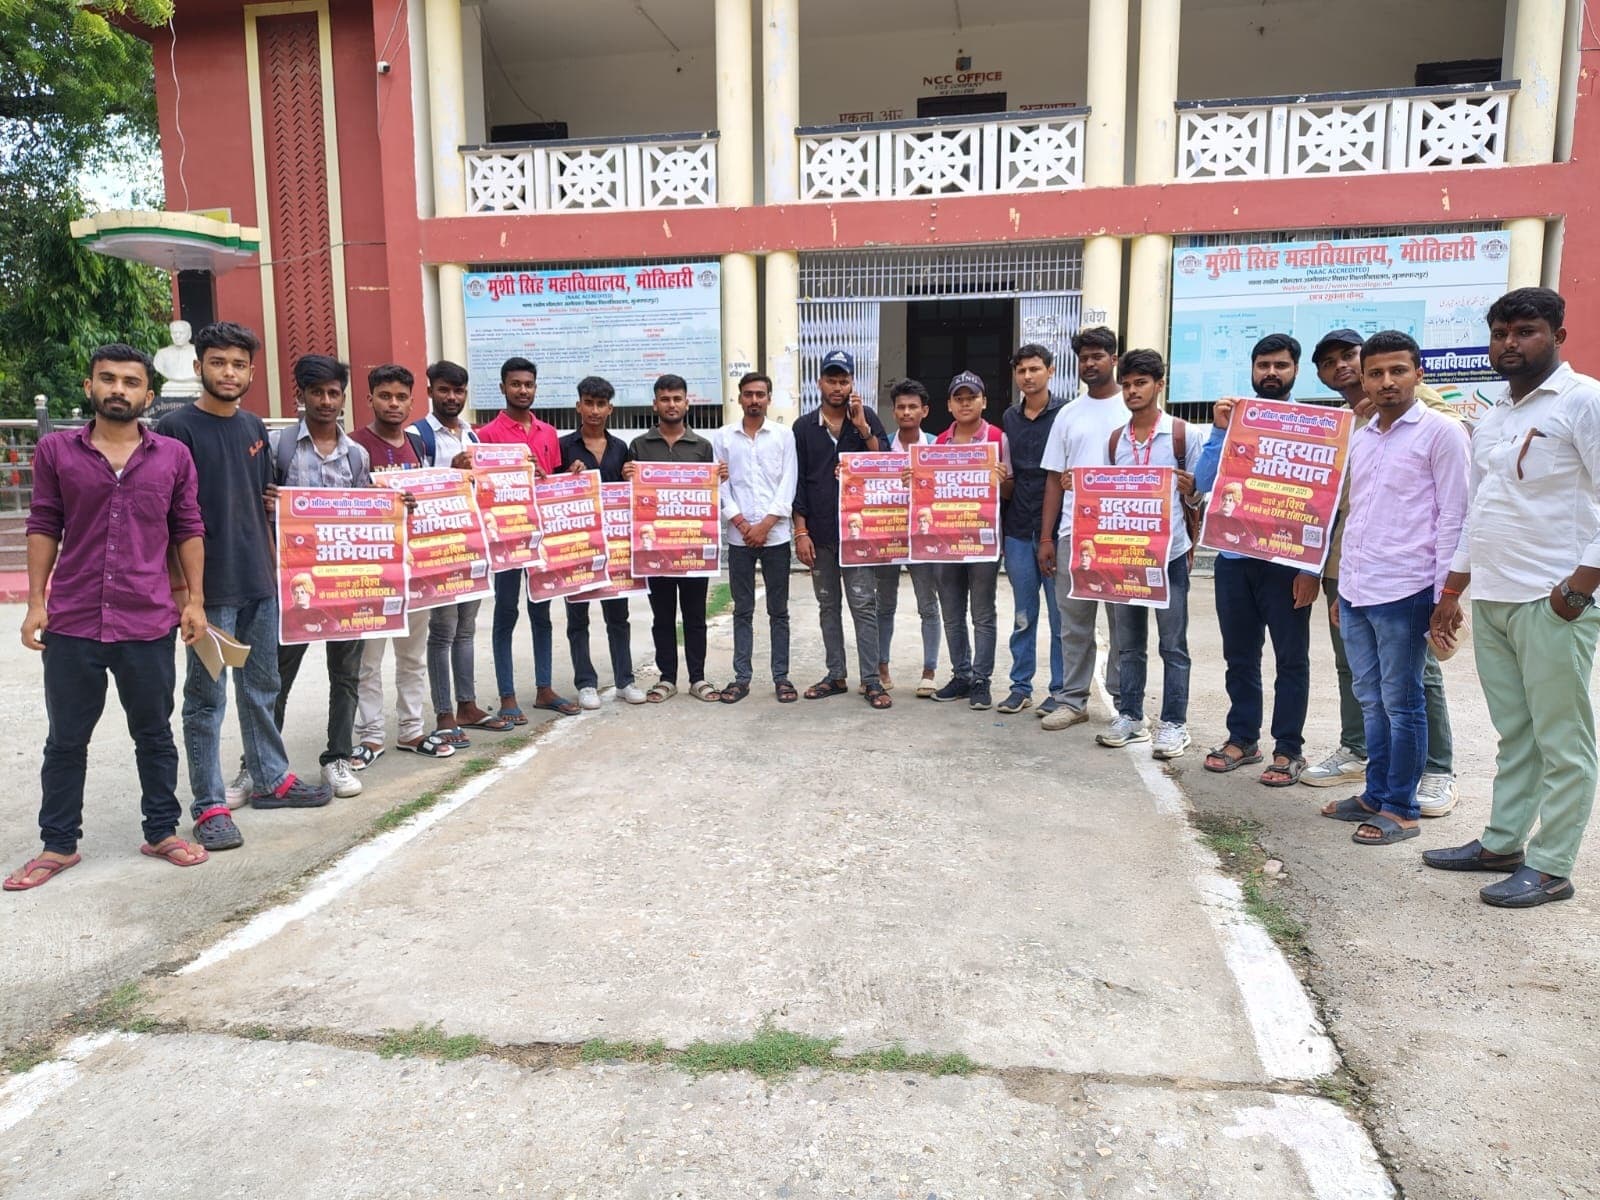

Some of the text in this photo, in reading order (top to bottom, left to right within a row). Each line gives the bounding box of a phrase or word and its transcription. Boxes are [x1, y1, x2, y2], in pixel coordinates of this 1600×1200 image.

[922, 71, 1003, 87] NCC OFFICE
[1205, 236, 1477, 280] मुंशी सिंह महाविद्यालय, मोतिहारी
[1328, 266, 1370, 275] ACCREDITED)
[487, 267, 693, 301] मुंशी सिंह महाविद्यालय, मोतिहारी
[1258, 436, 1338, 465] सदस्यता
[934, 470, 991, 484] सदस्यता
[1252, 455, 1333, 485] अभियान
[656, 489, 712, 504] सदस्यता
[934, 483, 991, 499] अभियान
[541, 498, 595, 519] सदस्यता
[656, 503, 712, 518] अभियान
[1099, 498, 1163, 515] सदस्यता
[412, 513, 473, 535] अभियान
[544, 514, 596, 534] अभियान
[1097, 513, 1162, 532] अभियान
[314, 524, 395, 542] सदस्यता
[316, 541, 394, 561] अभियान
